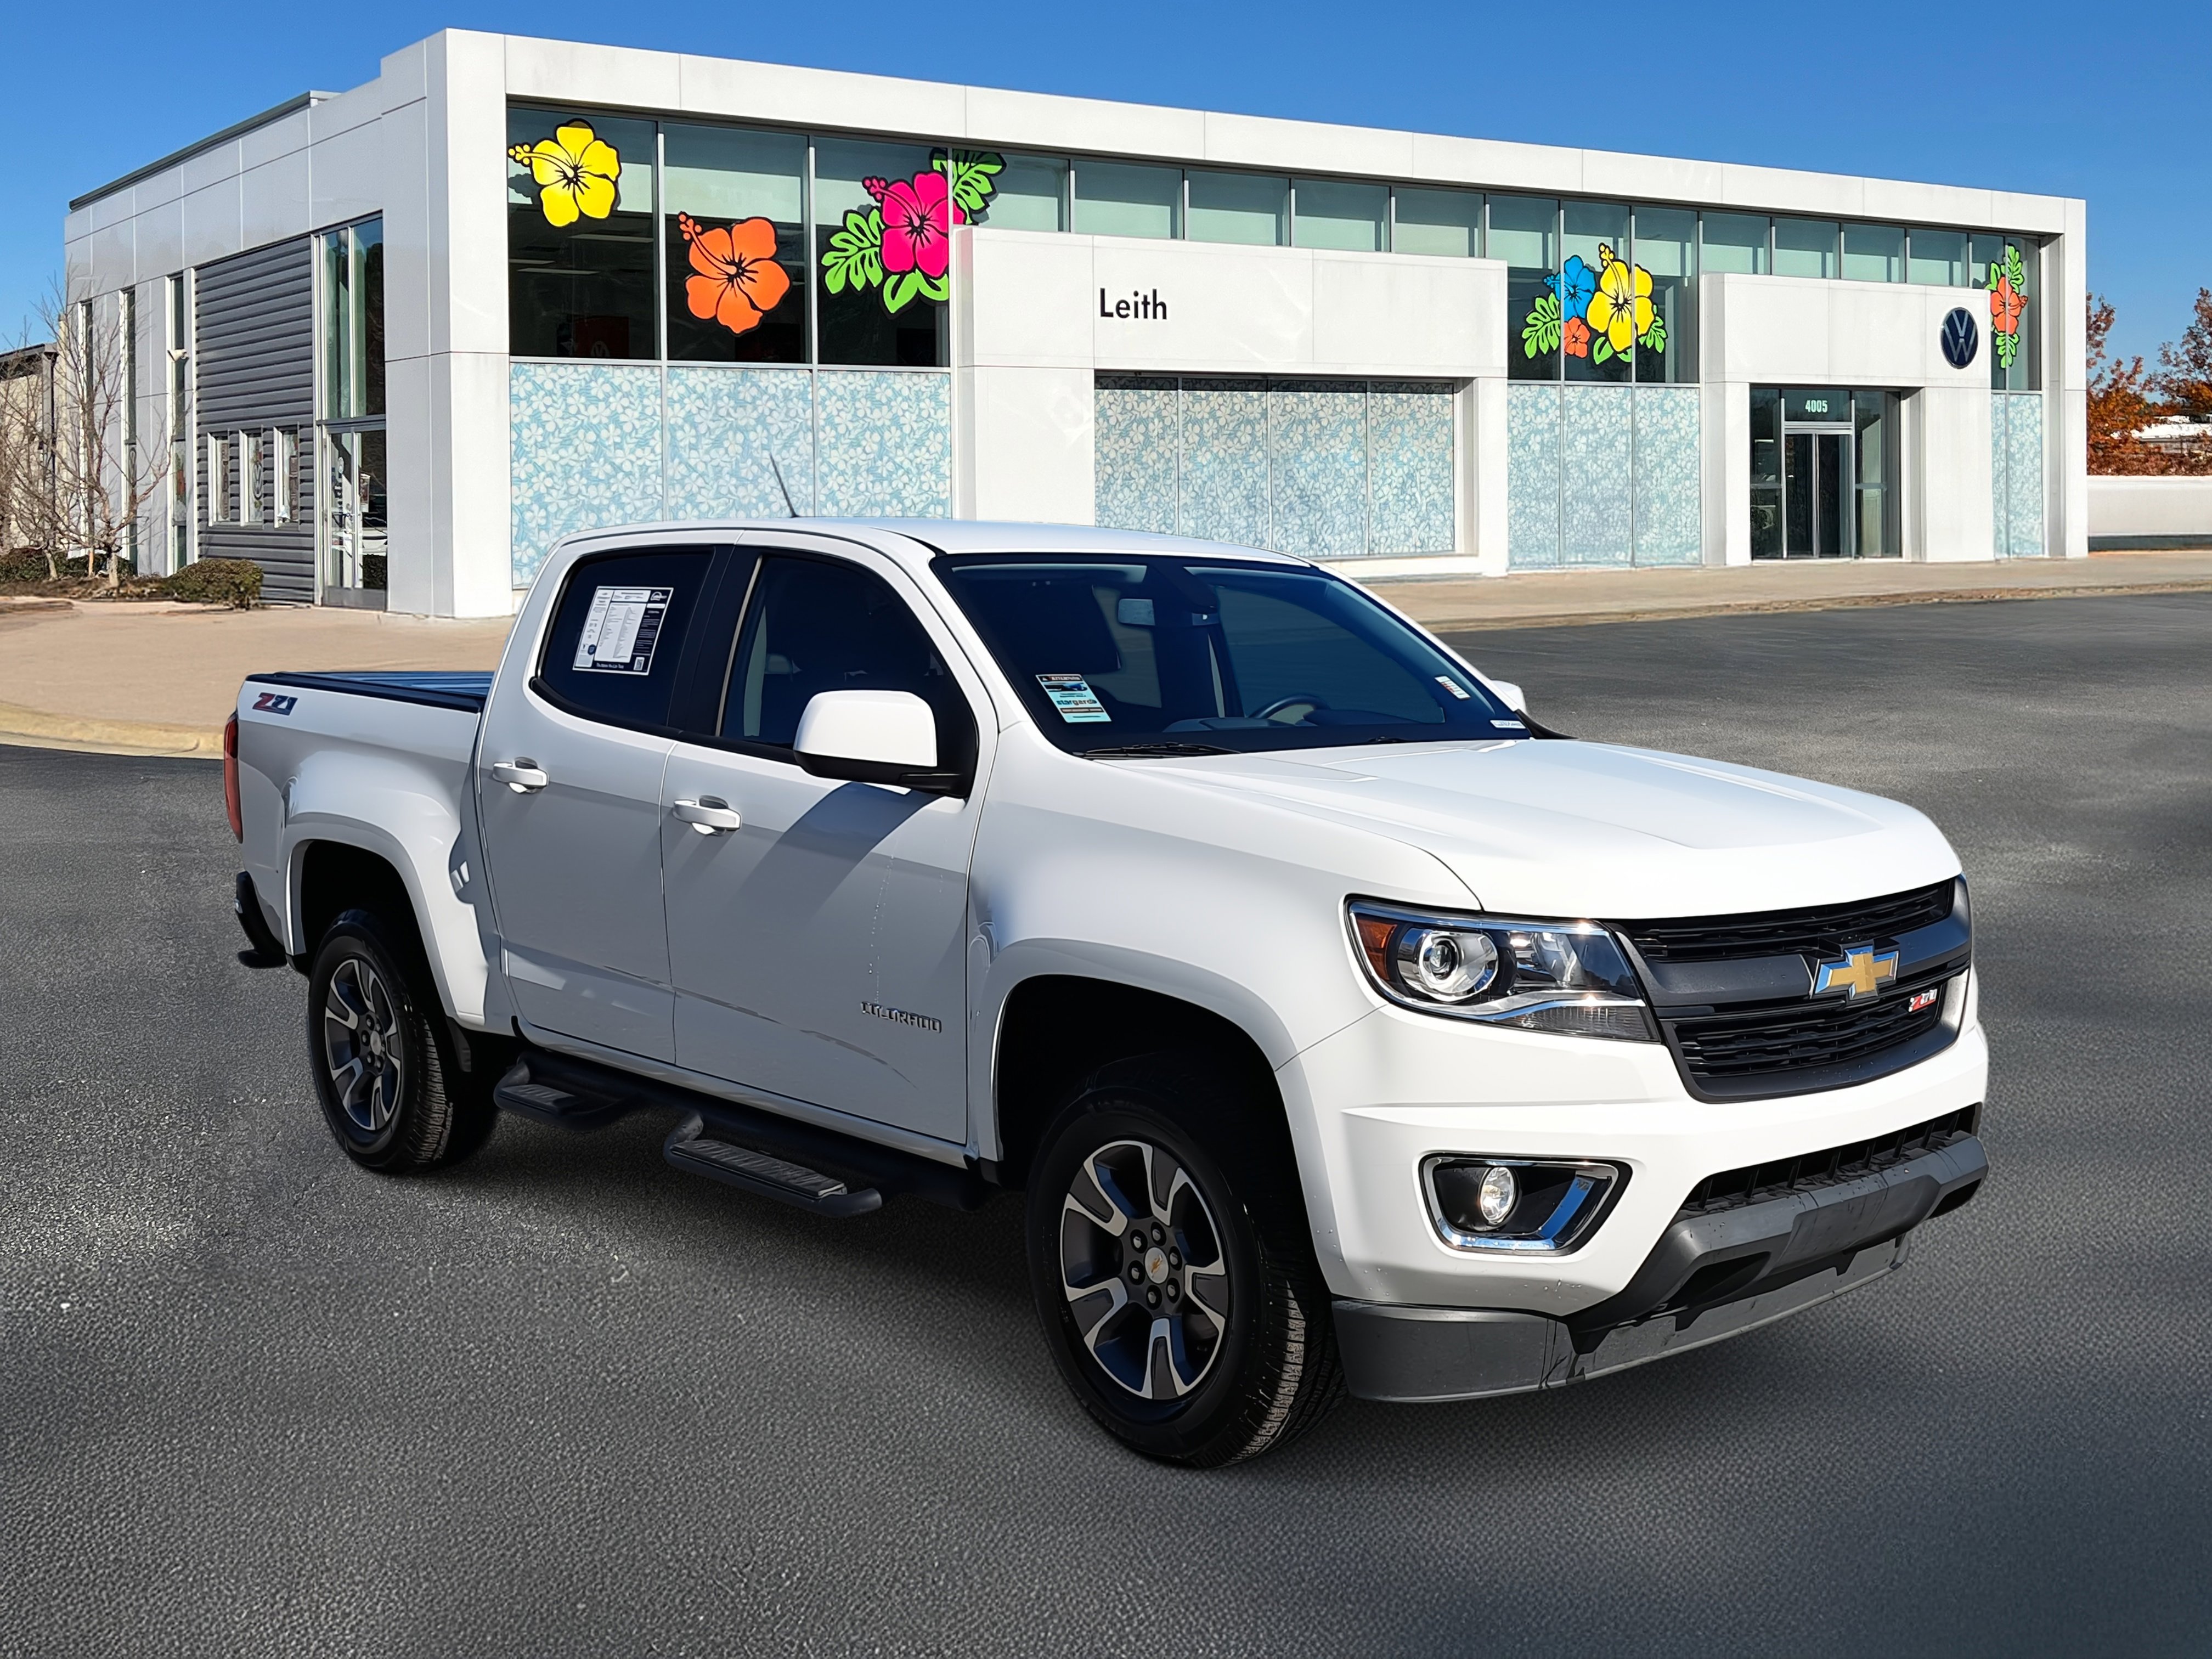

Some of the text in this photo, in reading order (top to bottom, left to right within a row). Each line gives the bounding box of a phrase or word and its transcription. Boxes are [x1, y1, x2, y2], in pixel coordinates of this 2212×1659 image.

[1100, 287, 1167, 320] Leith
[1805, 399, 1828, 413] 4005
[252, 692, 298, 716] Z71
[1909, 989, 1938, 1012] Z71
